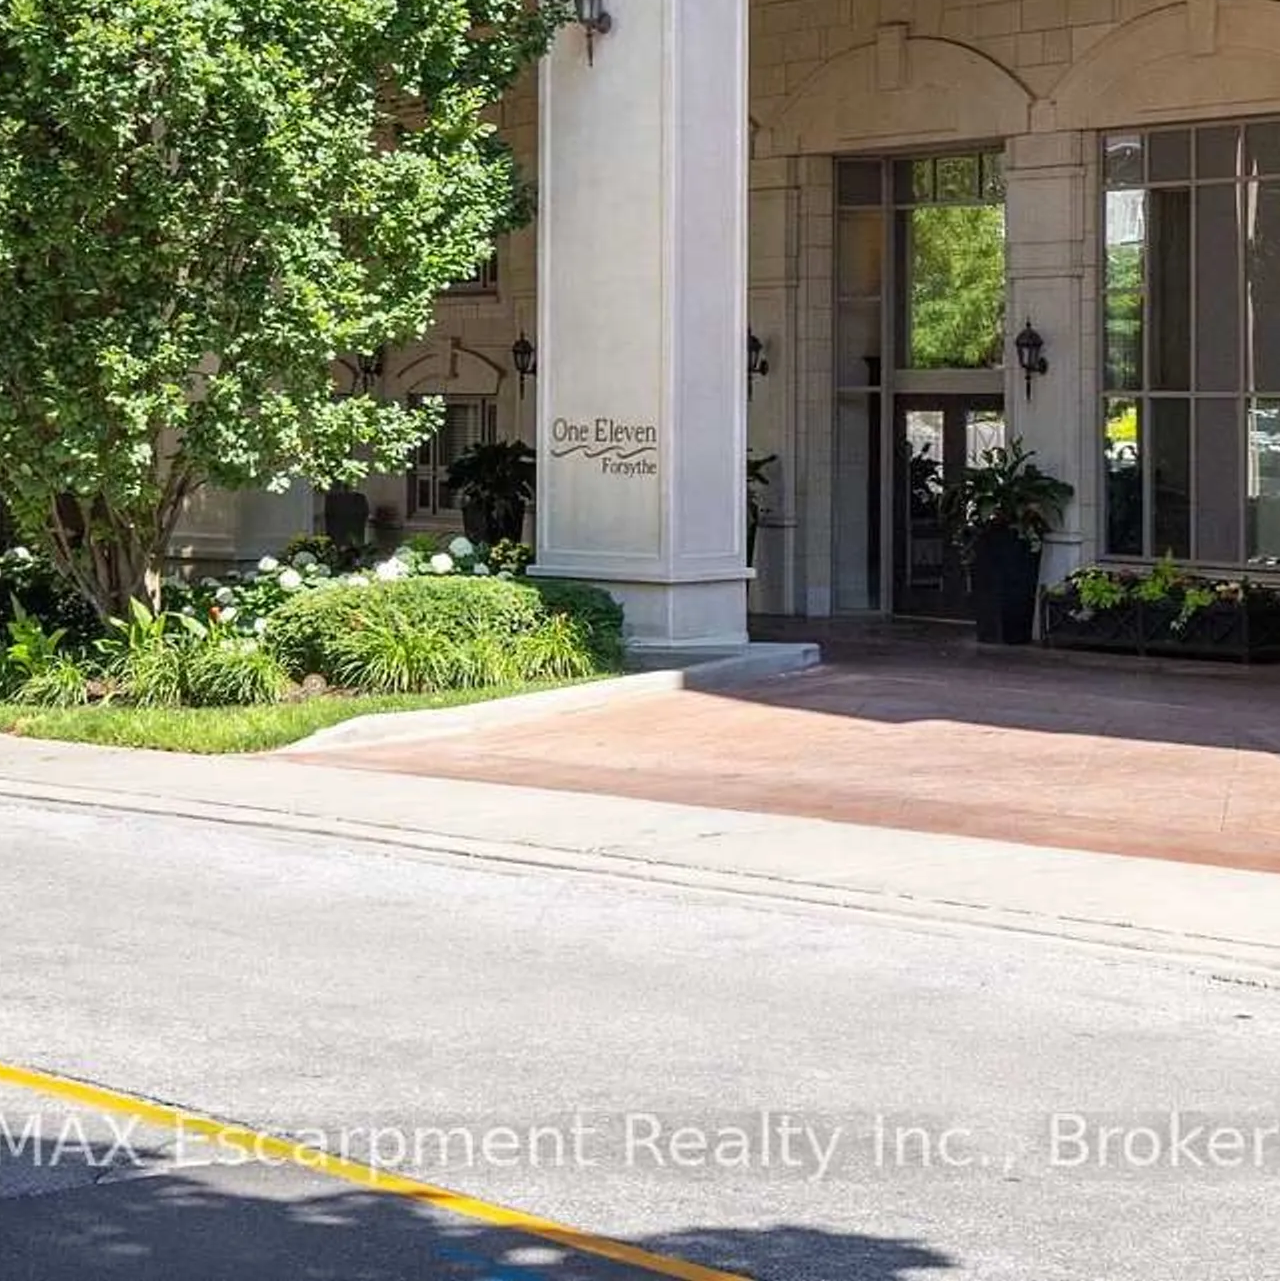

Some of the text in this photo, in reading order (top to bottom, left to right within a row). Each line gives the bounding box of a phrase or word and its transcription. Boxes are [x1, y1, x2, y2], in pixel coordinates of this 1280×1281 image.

[552, 418, 657, 442] One Eleven
[601, 457, 657, 477] Forsythe
